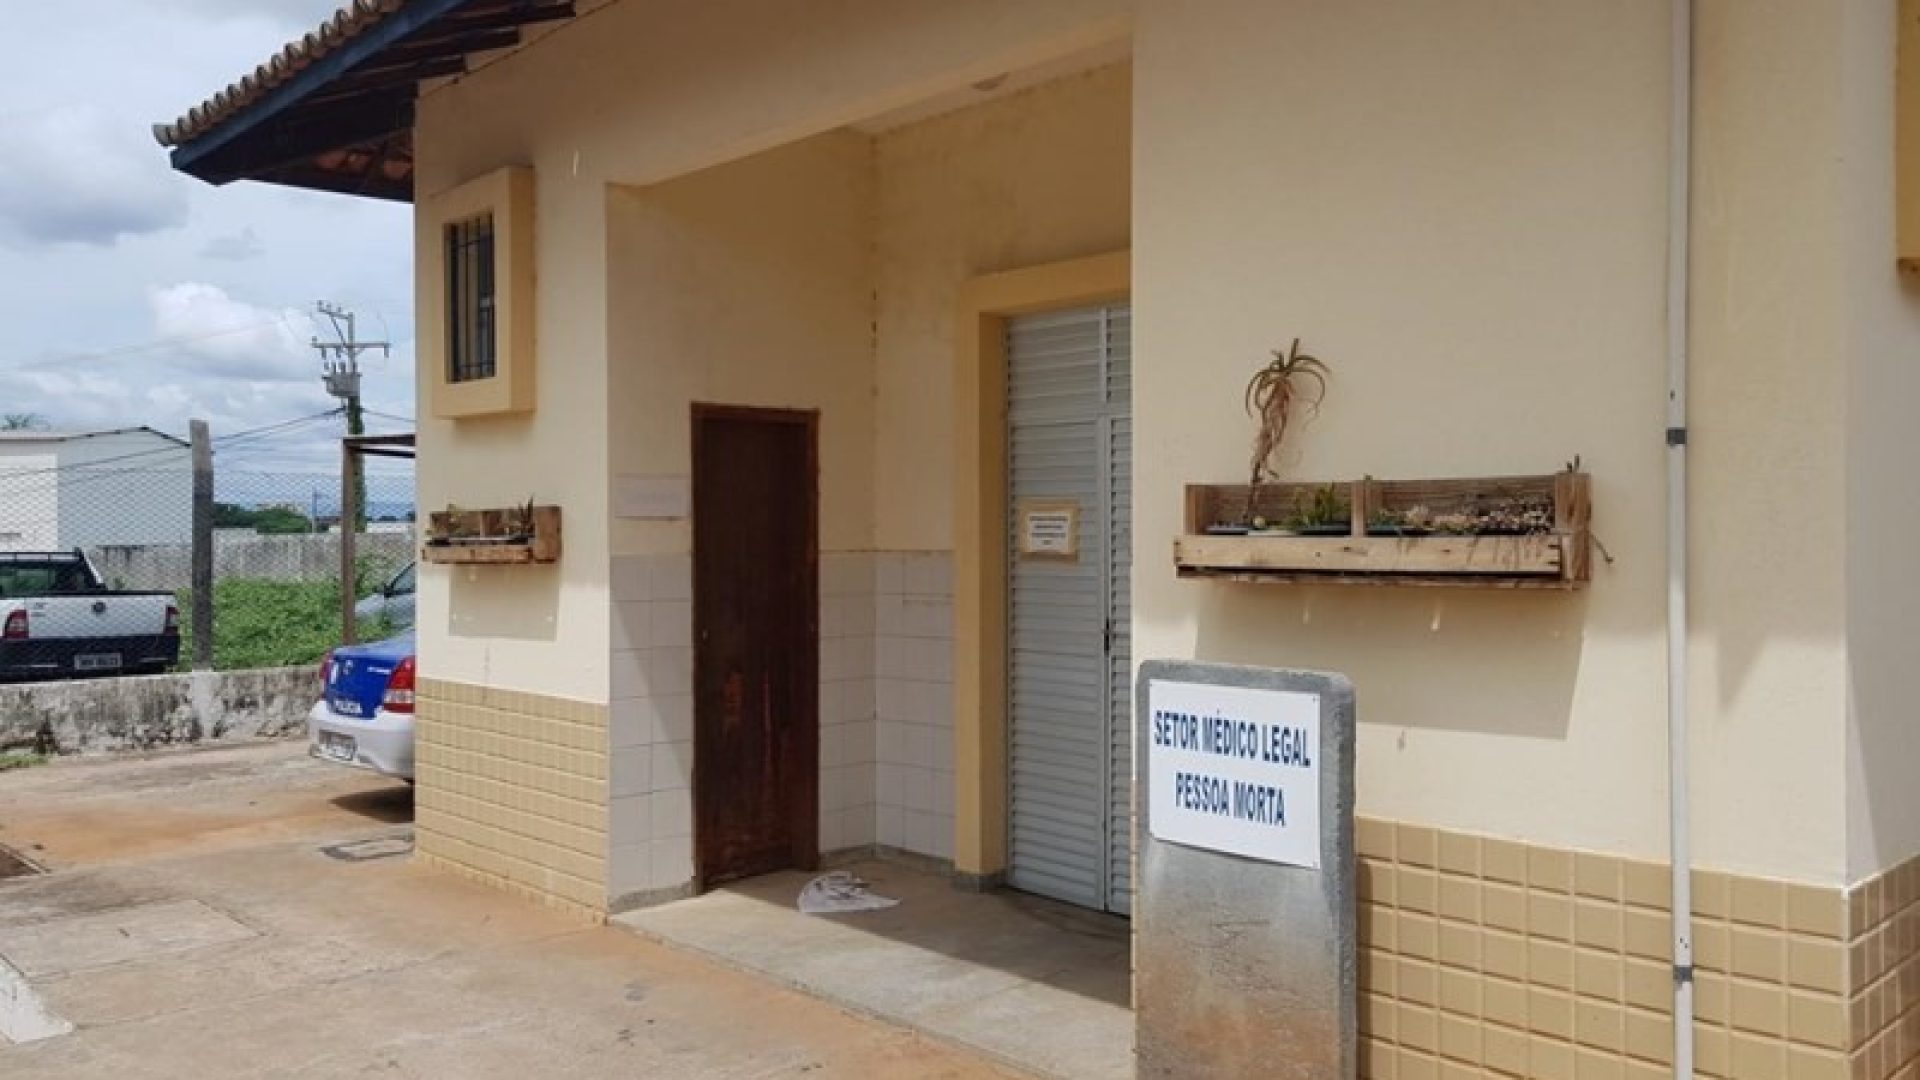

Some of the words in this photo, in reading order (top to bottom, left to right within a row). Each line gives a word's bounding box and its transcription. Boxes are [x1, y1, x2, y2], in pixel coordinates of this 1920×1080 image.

[1154, 710, 1198, 751] SETOR
[1202, 709, 1258, 759] MÉDICO
[1263, 724, 1311, 767] LEGAL
[1176, 772, 1229, 816] PESSOA
[1234, 781, 1286, 826] MORTA
